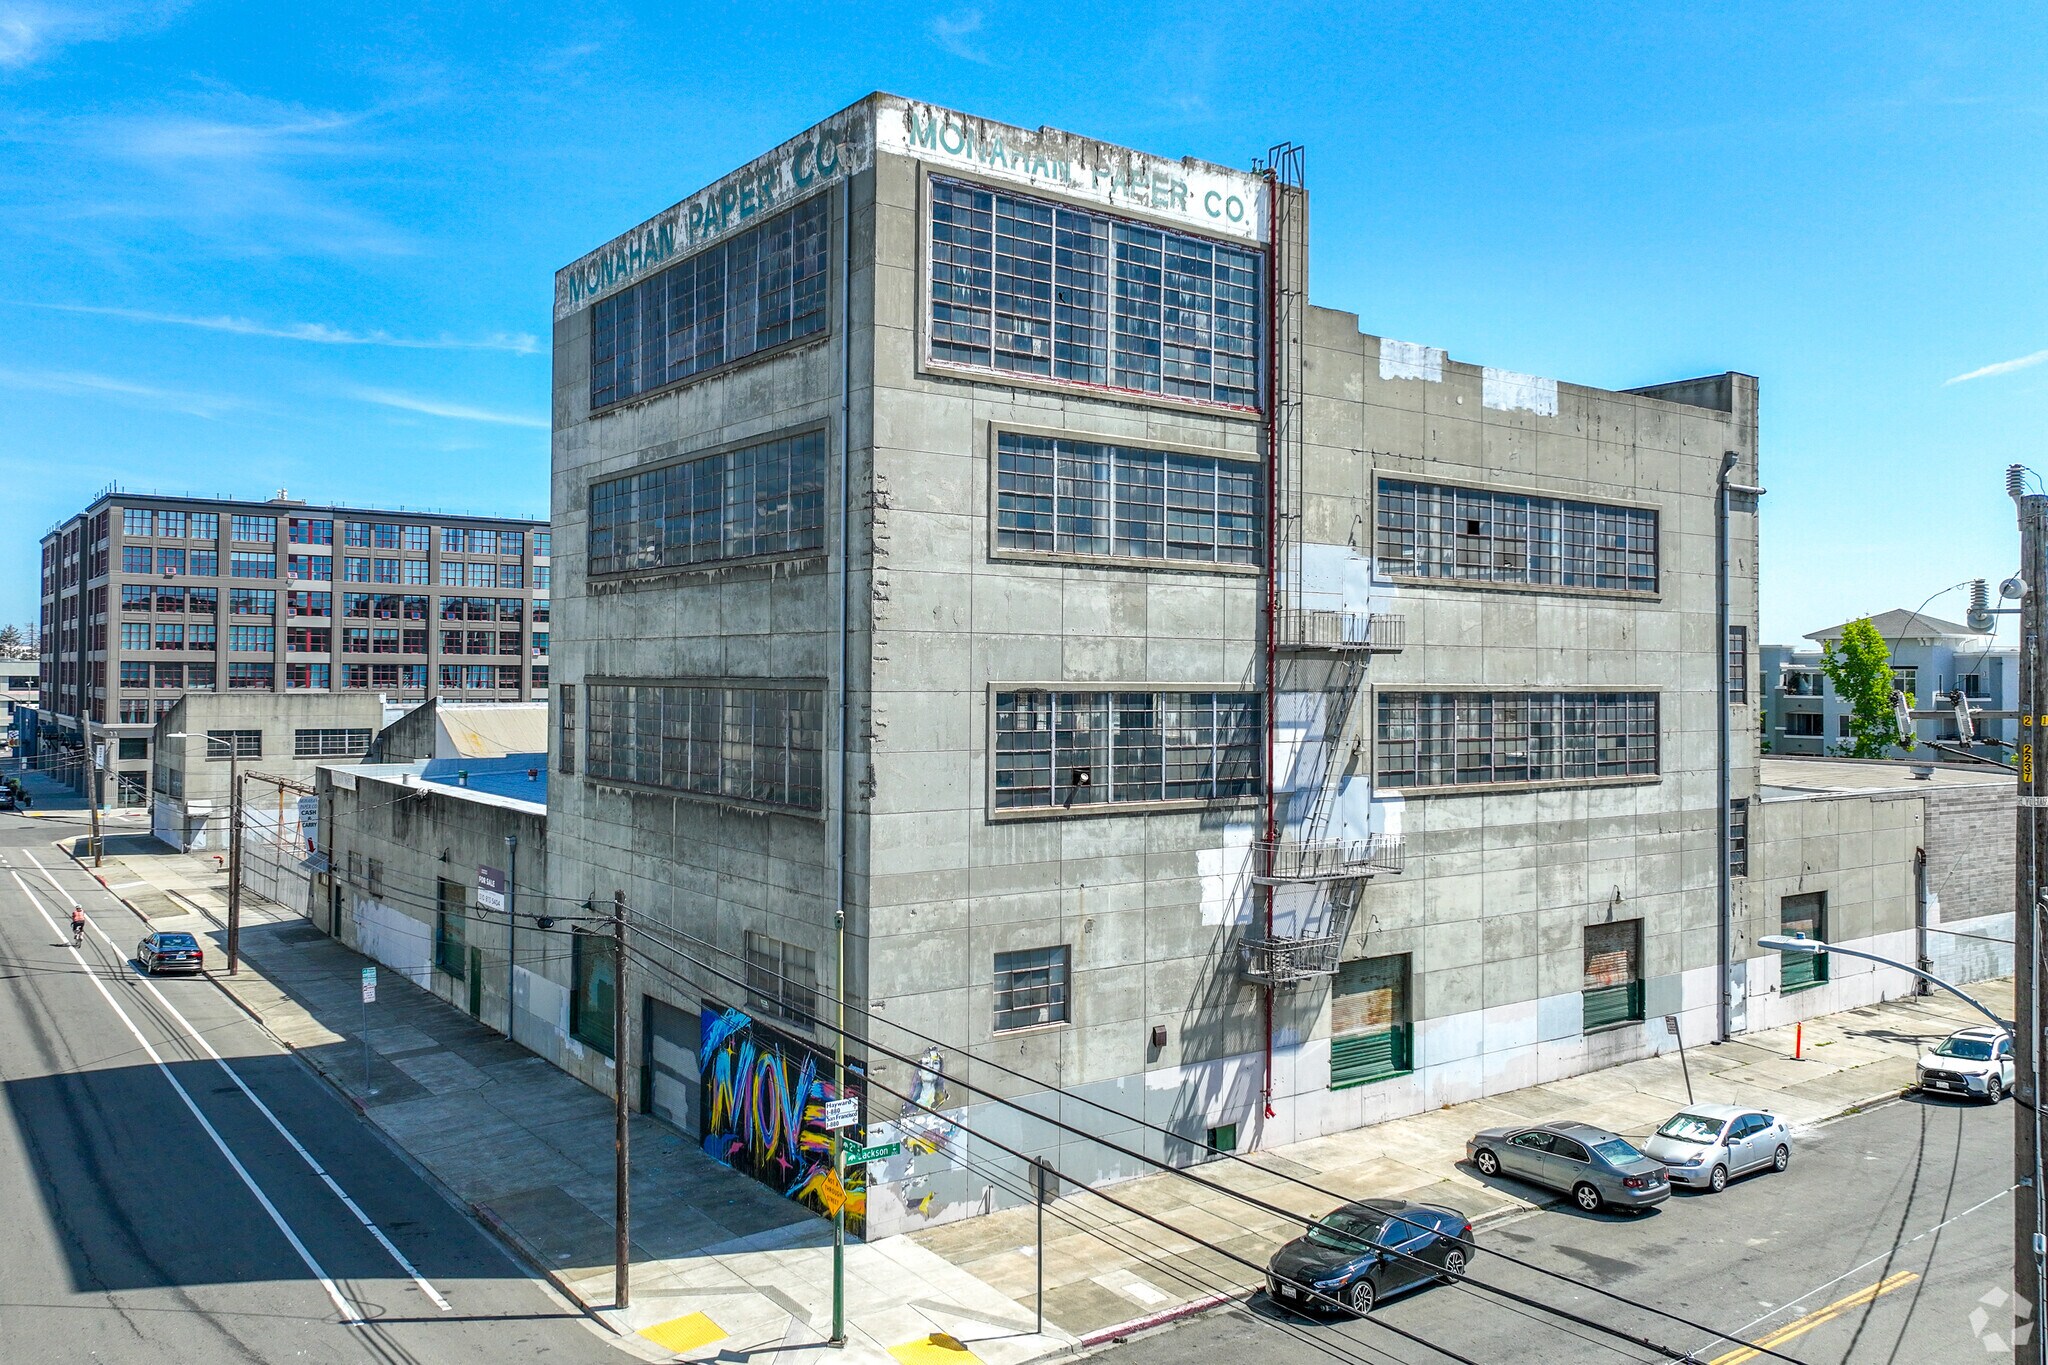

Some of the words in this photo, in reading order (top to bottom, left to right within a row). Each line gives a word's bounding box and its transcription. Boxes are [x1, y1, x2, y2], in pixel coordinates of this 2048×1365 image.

[910, 113, 1071, 183] MONAHAN
[1092, 165, 1188, 211] PAPER
[1204, 190, 1250, 226] CO.
[569, 223, 675, 304] MONAHAN
[689, 164, 777, 246] PAPER
[2024, 716, 2031, 725] 2
[826, 1099, 852, 1109] Hayward
[835, 1112, 858, 1120] Francisco
[827, 1177, 835, 1185] NOT
[825, 1184, 843, 1197] THROUGH
